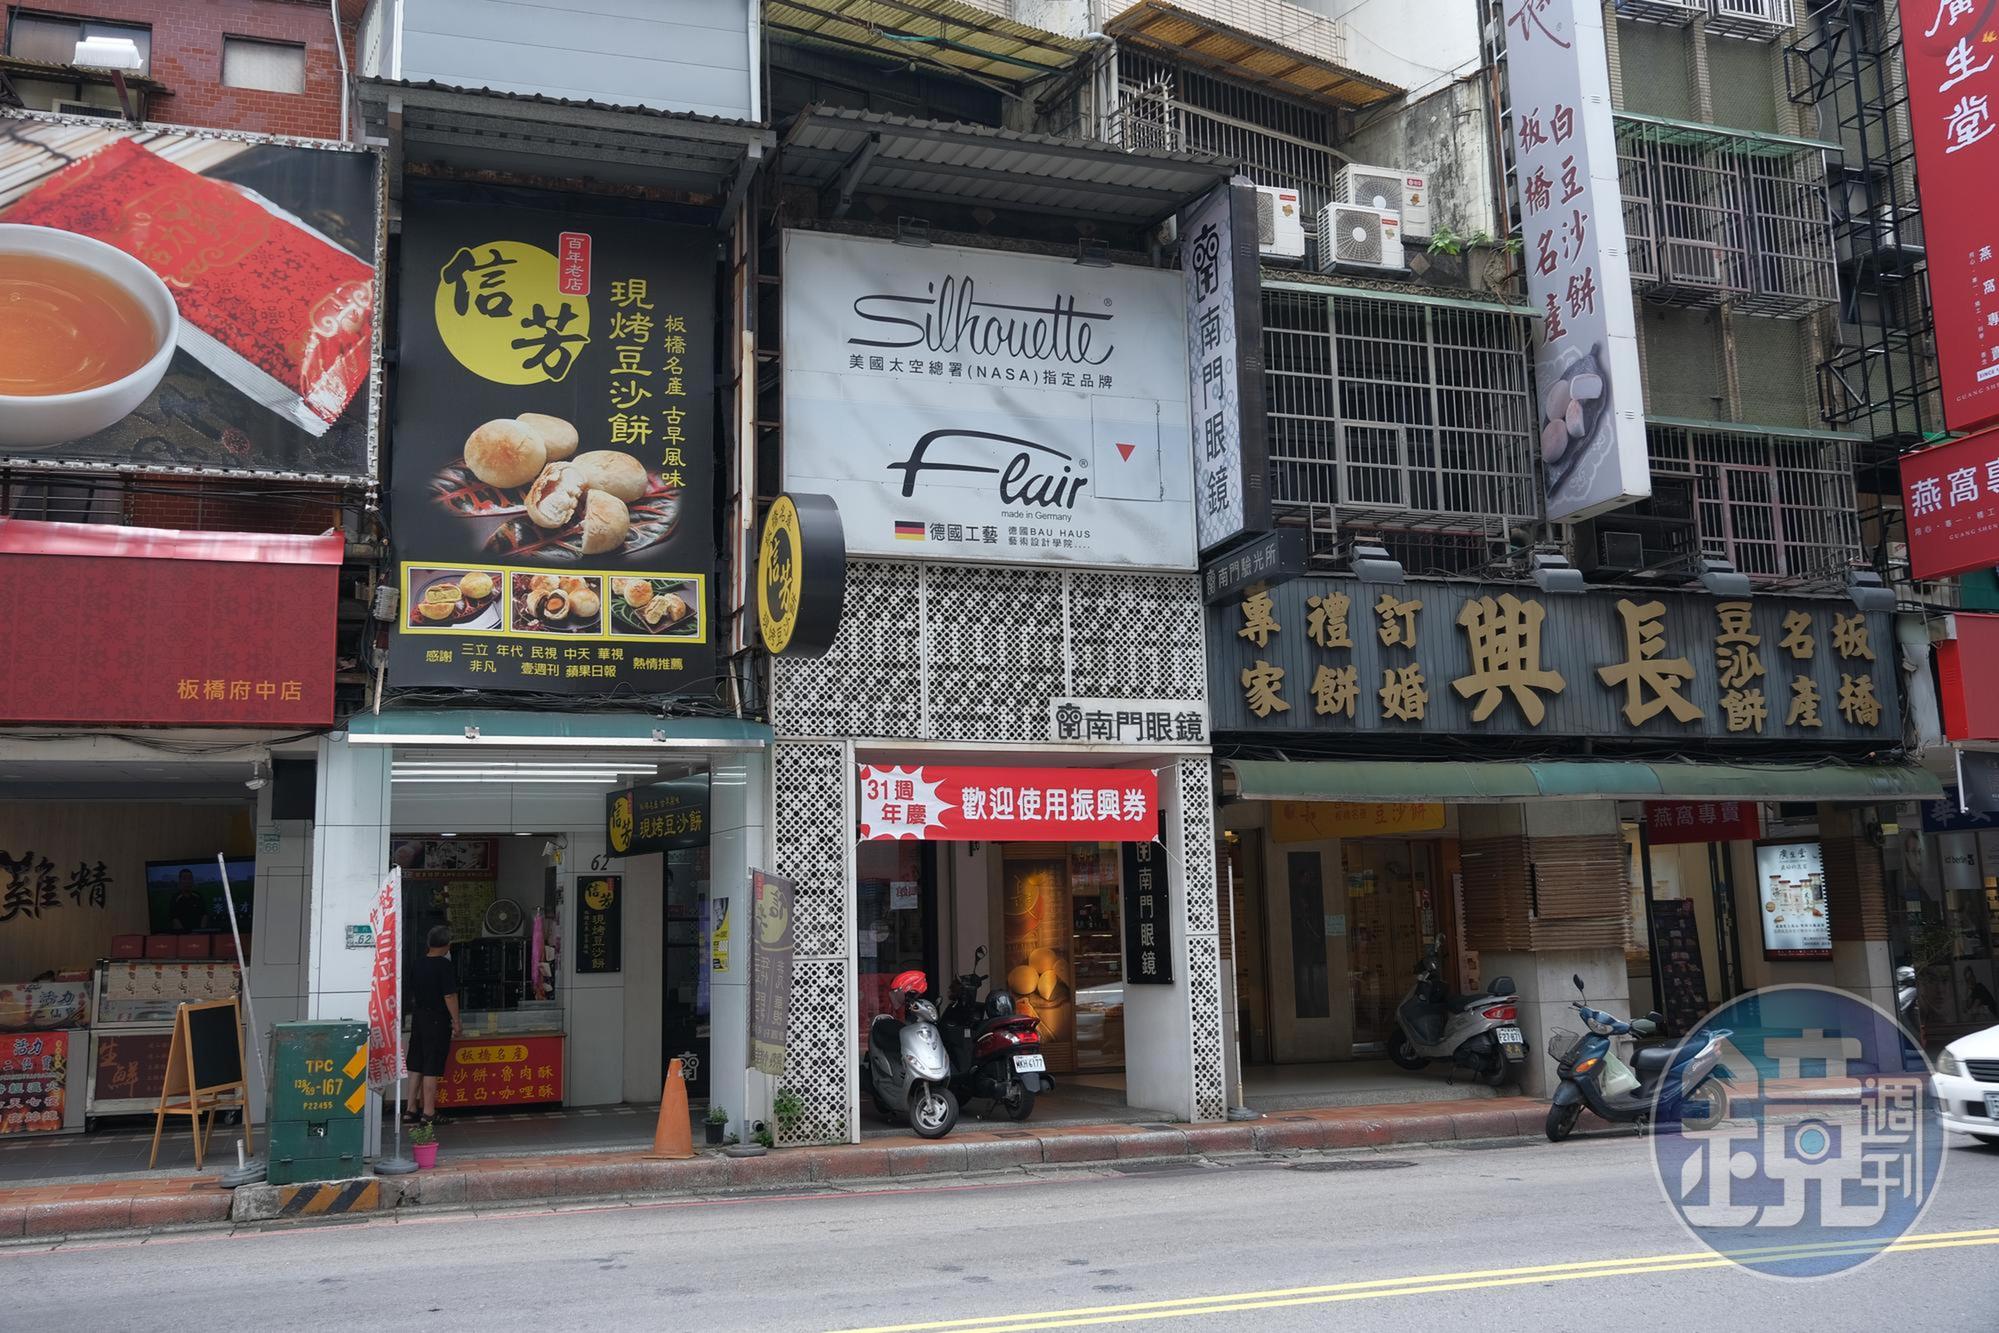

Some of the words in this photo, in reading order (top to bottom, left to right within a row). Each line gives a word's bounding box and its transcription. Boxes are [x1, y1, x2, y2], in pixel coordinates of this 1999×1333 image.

[1518, 108, 1569, 347] 板橋名產
[1549, 103, 1596, 320] 白豆沙餅
[564, 237, 584, 291] 百年老店
[848, 274, 1114, 365] Silhouette
[608, 278, 654, 445] 現烤豆沙餅
[662, 314, 687, 396] 板橋名產
[849, 354, 1113, 389] 美國太空總署(NASA)指定品牌
[1199, 306, 1229, 517] 南門眼鏡
[662, 406, 687, 487] 古早風味
[886, 428, 1088, 509] Flair
[930, 522, 999, 544] 德國工藝
[1035, 511, 1072, 522] Germany
[1060, 529, 1091, 538] HAUS
[426, 650, 452, 664] 感謝
[462, 643, 488, 656] 三立
[496, 644, 523, 657] 年代
[531, 646, 557, 659] 民視
[564, 647, 589, 660] 中天
[597, 648, 624, 661] 華視
[470, 660, 496, 673] 非凡
[521, 662, 559, 676] 壹週刊
[566, 664, 616, 678] 蘋果日報
[633, 657, 683, 671] 熱情推薦
[1238, 589, 1291, 717] 專家
[1306, 592, 1360, 719] 禮餅
[1375, 594, 1429, 722] 訂婚
[1715, 601, 1768, 734] 豆沙餅
[1778, 609, 1824, 728] 名產
[1832, 612, 1882, 728] 板橋
[177, 679, 302, 701] 板橋府中店
[1085, 710, 1204, 742] 南門眼鏡
[867, 779, 914, 801] 31週
[962, 786, 1147, 822] 歡迎使用振興券
[640, 809, 703, 840] 現烤豆沙餅
[881, 803, 927, 826] 年慶
[591, 855, 609, 871] 62
[1139, 866, 1157, 977] 南門眼鏡
[305, 1059, 334, 1073] TPC
